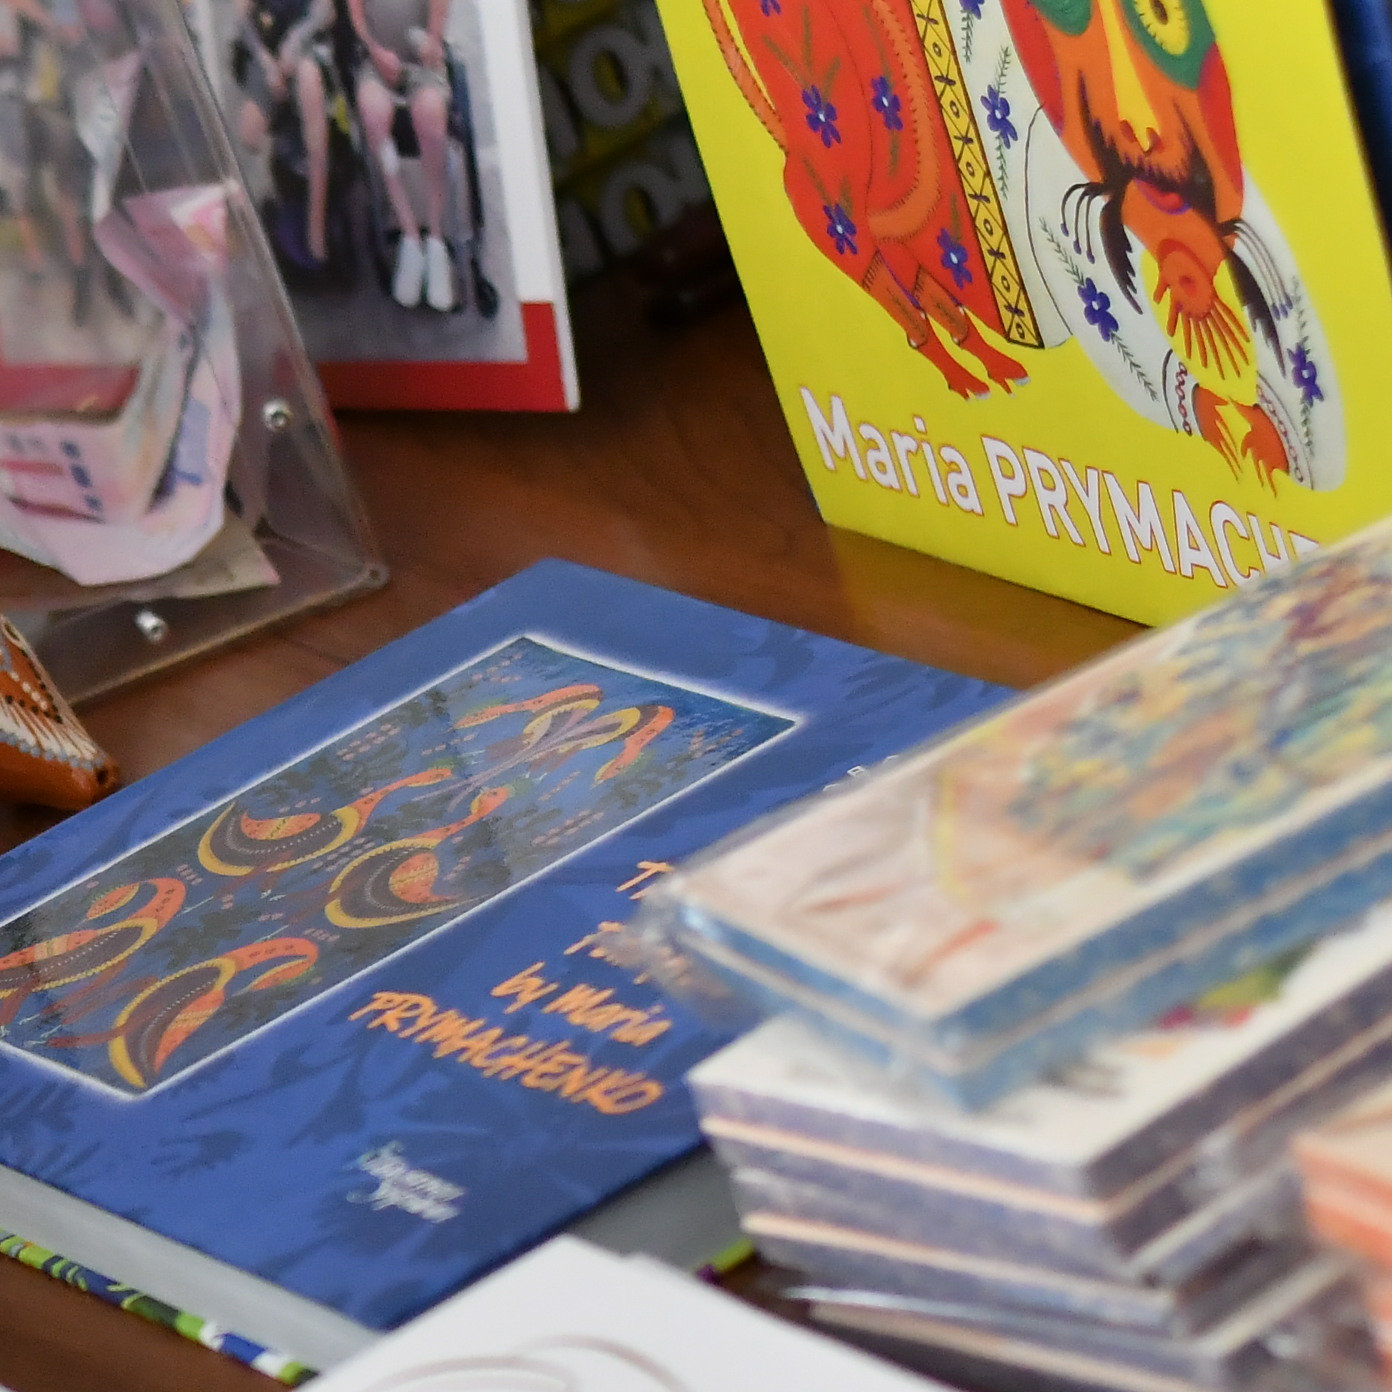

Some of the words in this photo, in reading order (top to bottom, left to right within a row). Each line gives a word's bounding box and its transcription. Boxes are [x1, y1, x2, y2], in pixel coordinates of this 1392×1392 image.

[799, 384, 984, 516] Maria
[347, 989, 665, 1116] PRYMACHENKO
[489, 960, 560, 1015] by
[540, 982, 673, 1047] Maria
